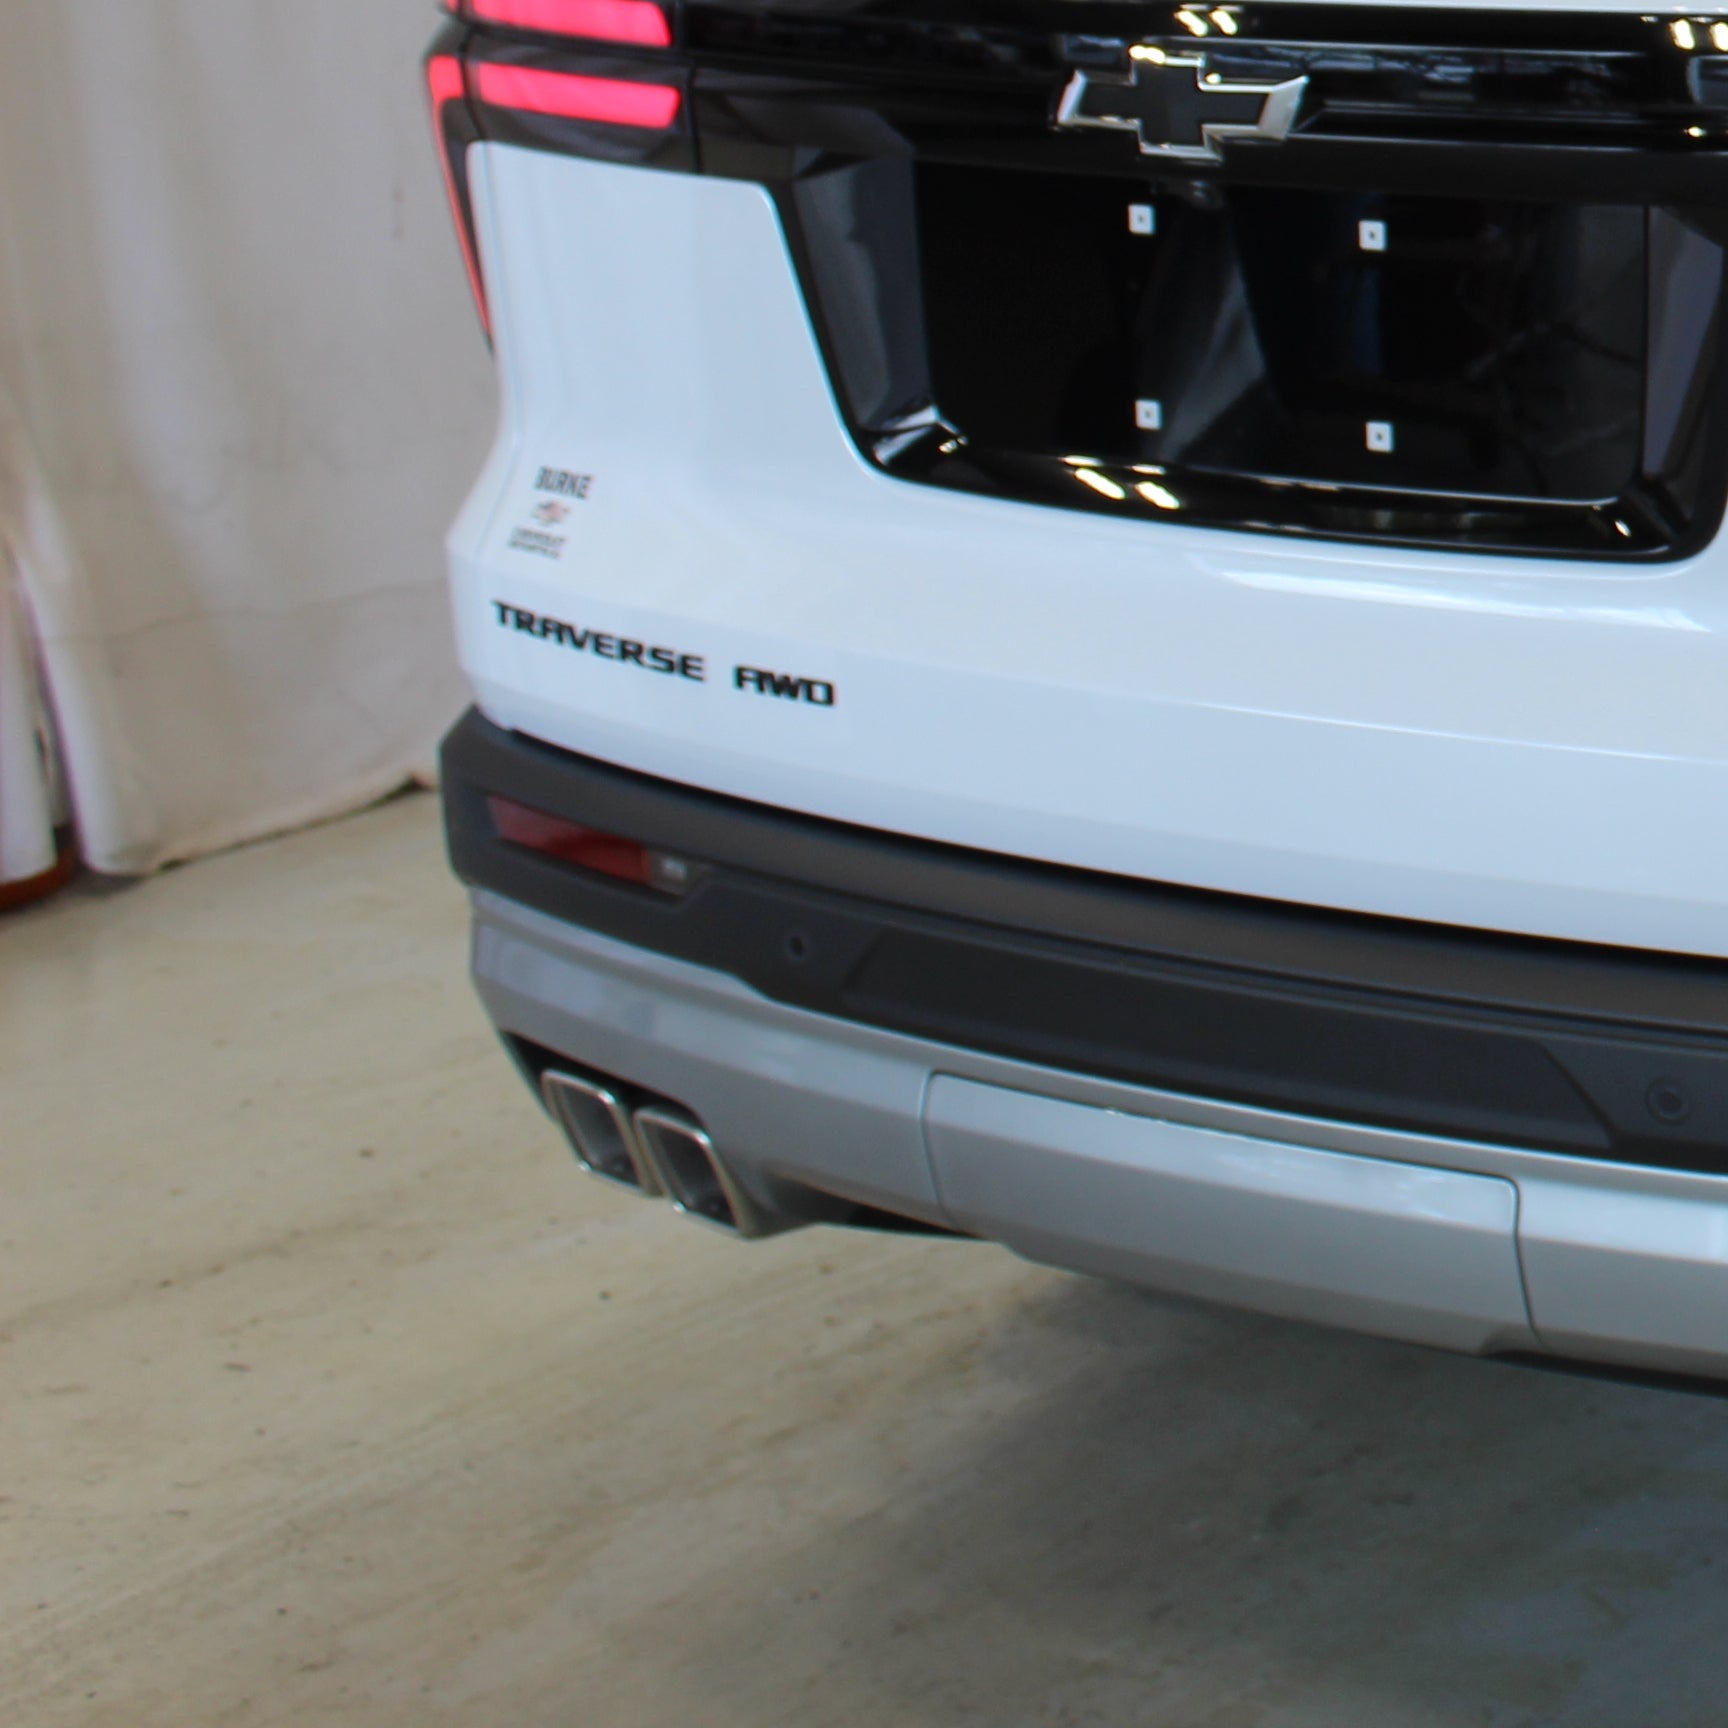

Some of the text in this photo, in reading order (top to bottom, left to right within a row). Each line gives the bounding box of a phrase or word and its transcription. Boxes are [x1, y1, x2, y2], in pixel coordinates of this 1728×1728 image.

[533, 466, 594, 500] BURKE
[492, 600, 836, 706] TRAVERSE AWD
